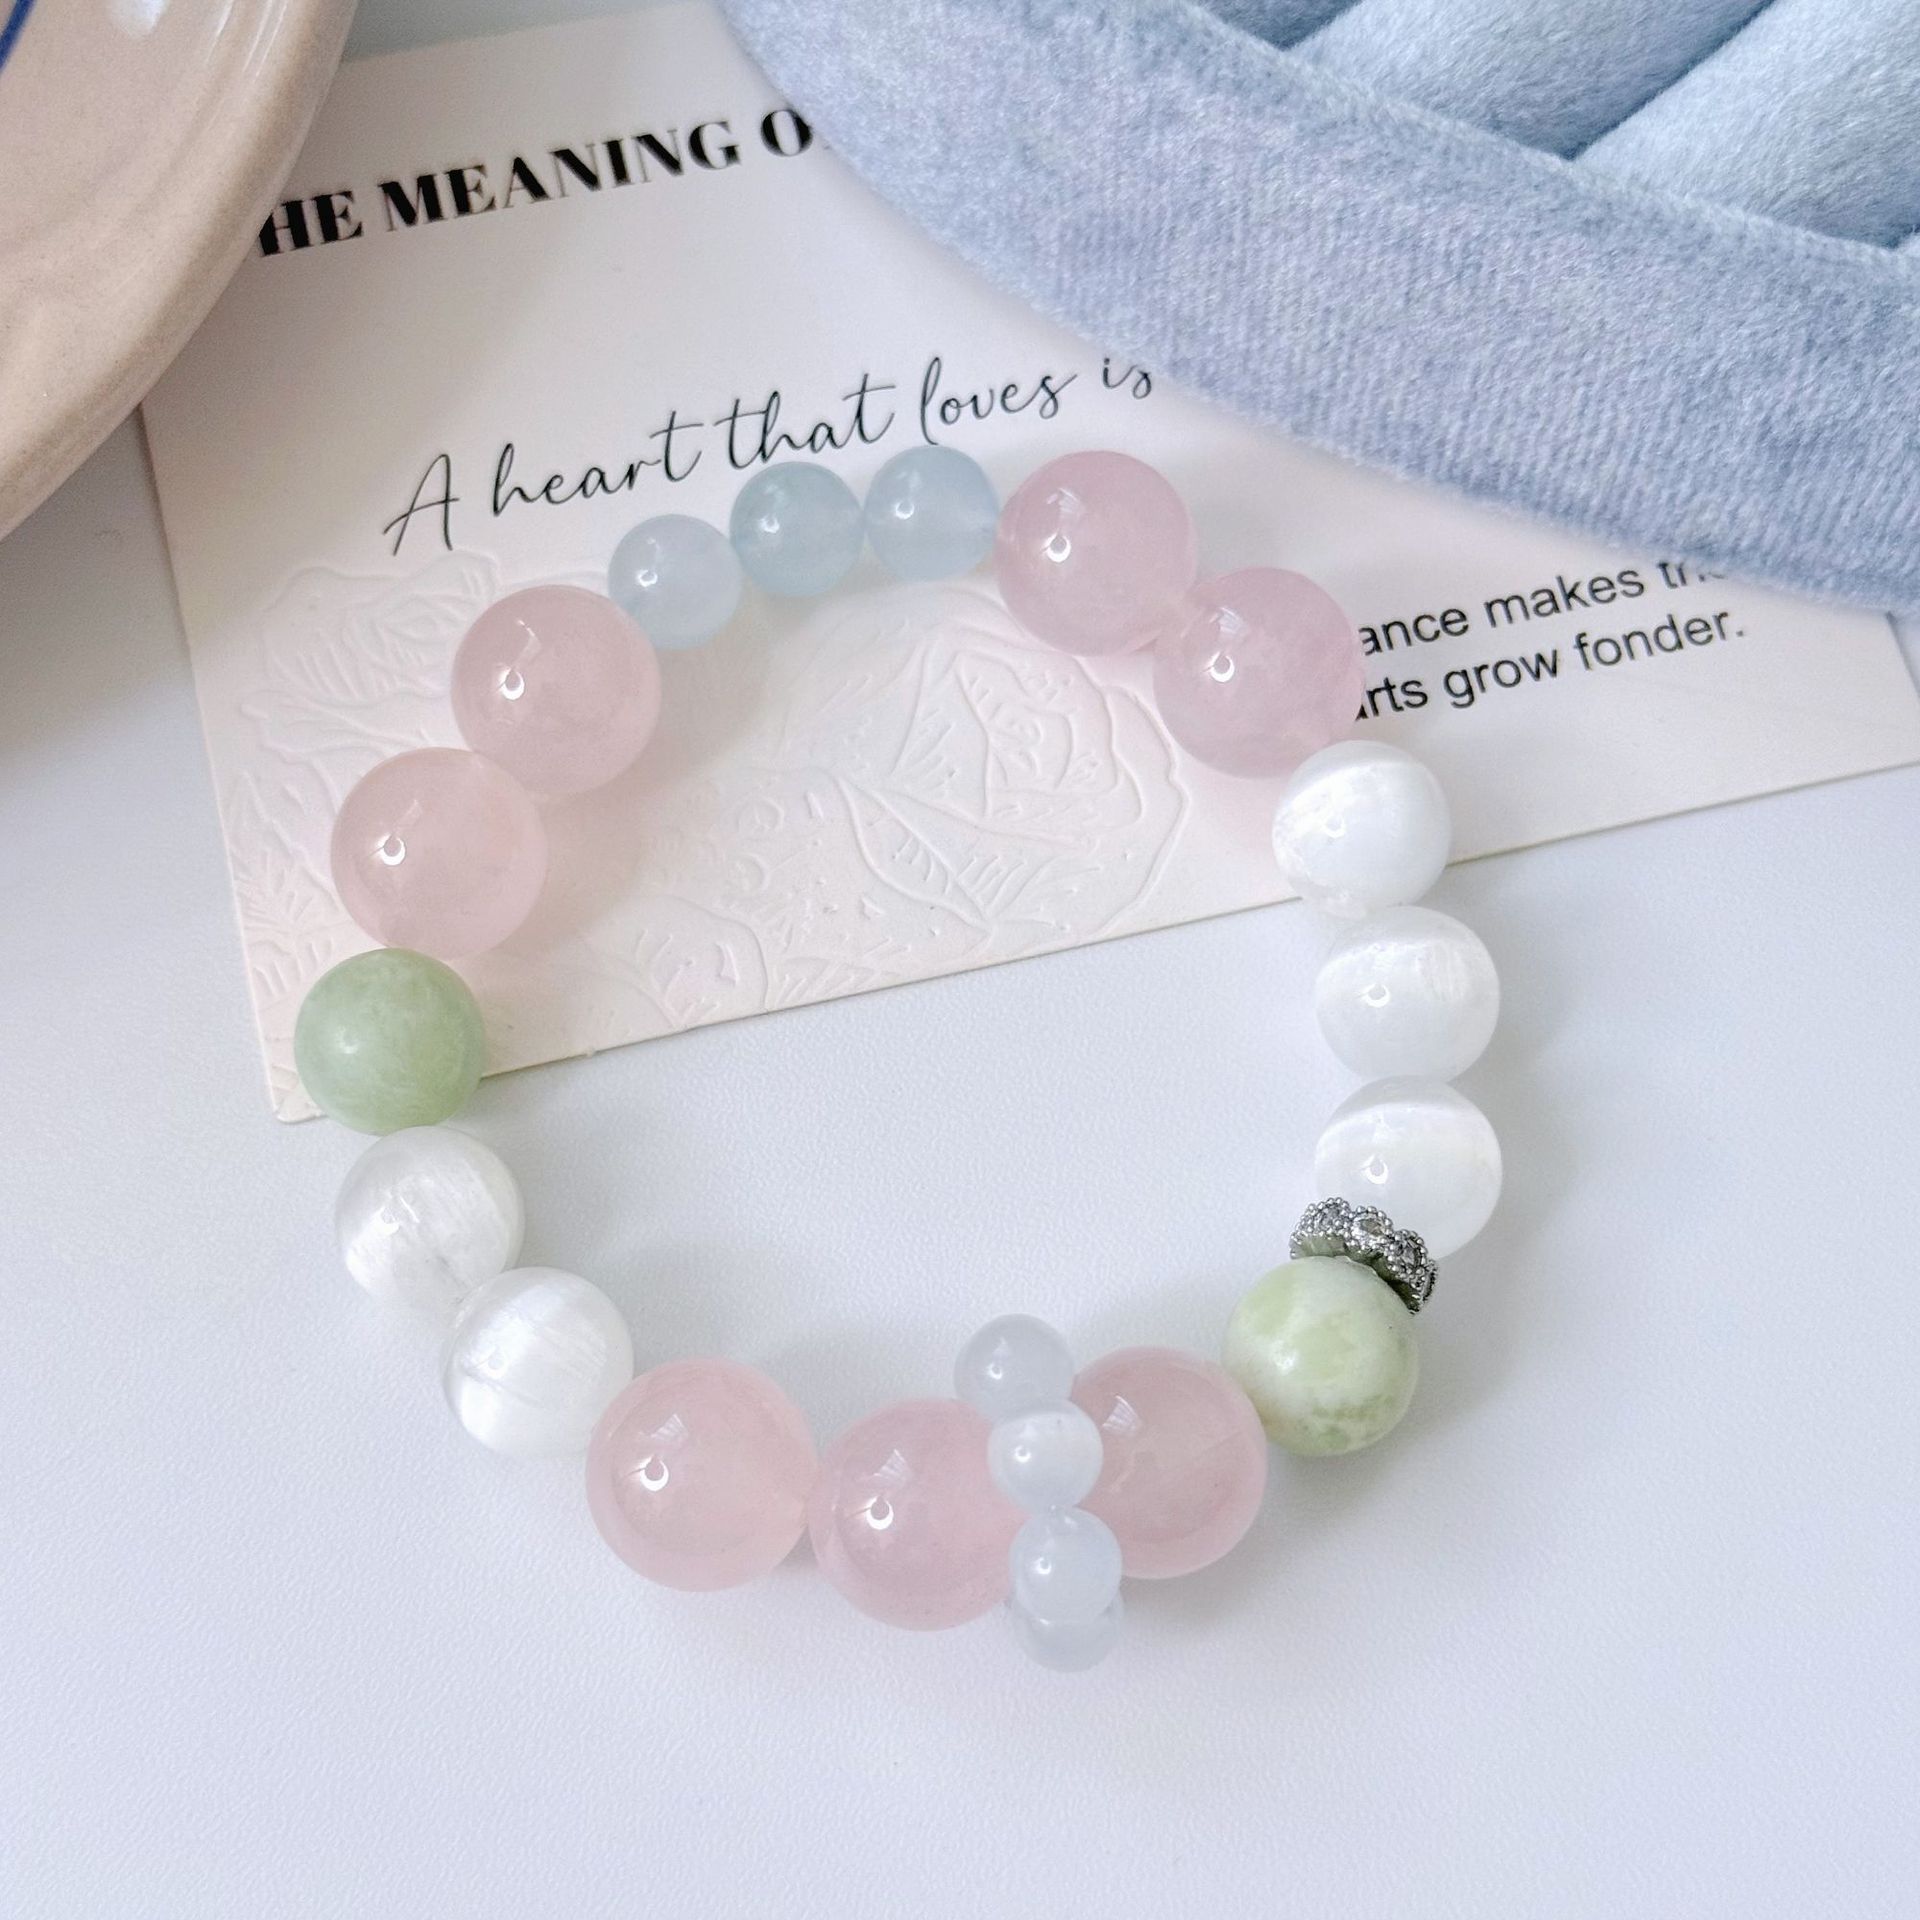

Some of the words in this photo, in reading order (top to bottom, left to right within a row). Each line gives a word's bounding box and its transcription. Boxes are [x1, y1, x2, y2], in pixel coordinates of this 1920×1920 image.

[257, 189, 364, 257] HE
[376, 120, 742, 233] MEANING
[760, 107, 815, 157] O
[383, 453, 460, 557] A
[492, 410, 704, 518] heart
[713, 372, 897, 471] that
[918, 356, 1078, 446] loves
[1102, 356, 1153, 400] is
[1354, 676, 1429, 721] rts
[1442, 648, 1561, 710] grow
[1572, 611, 1746, 671] fonder.
[1358, 607, 1470, 657] ance
[1482, 569, 1645, 629] makes
